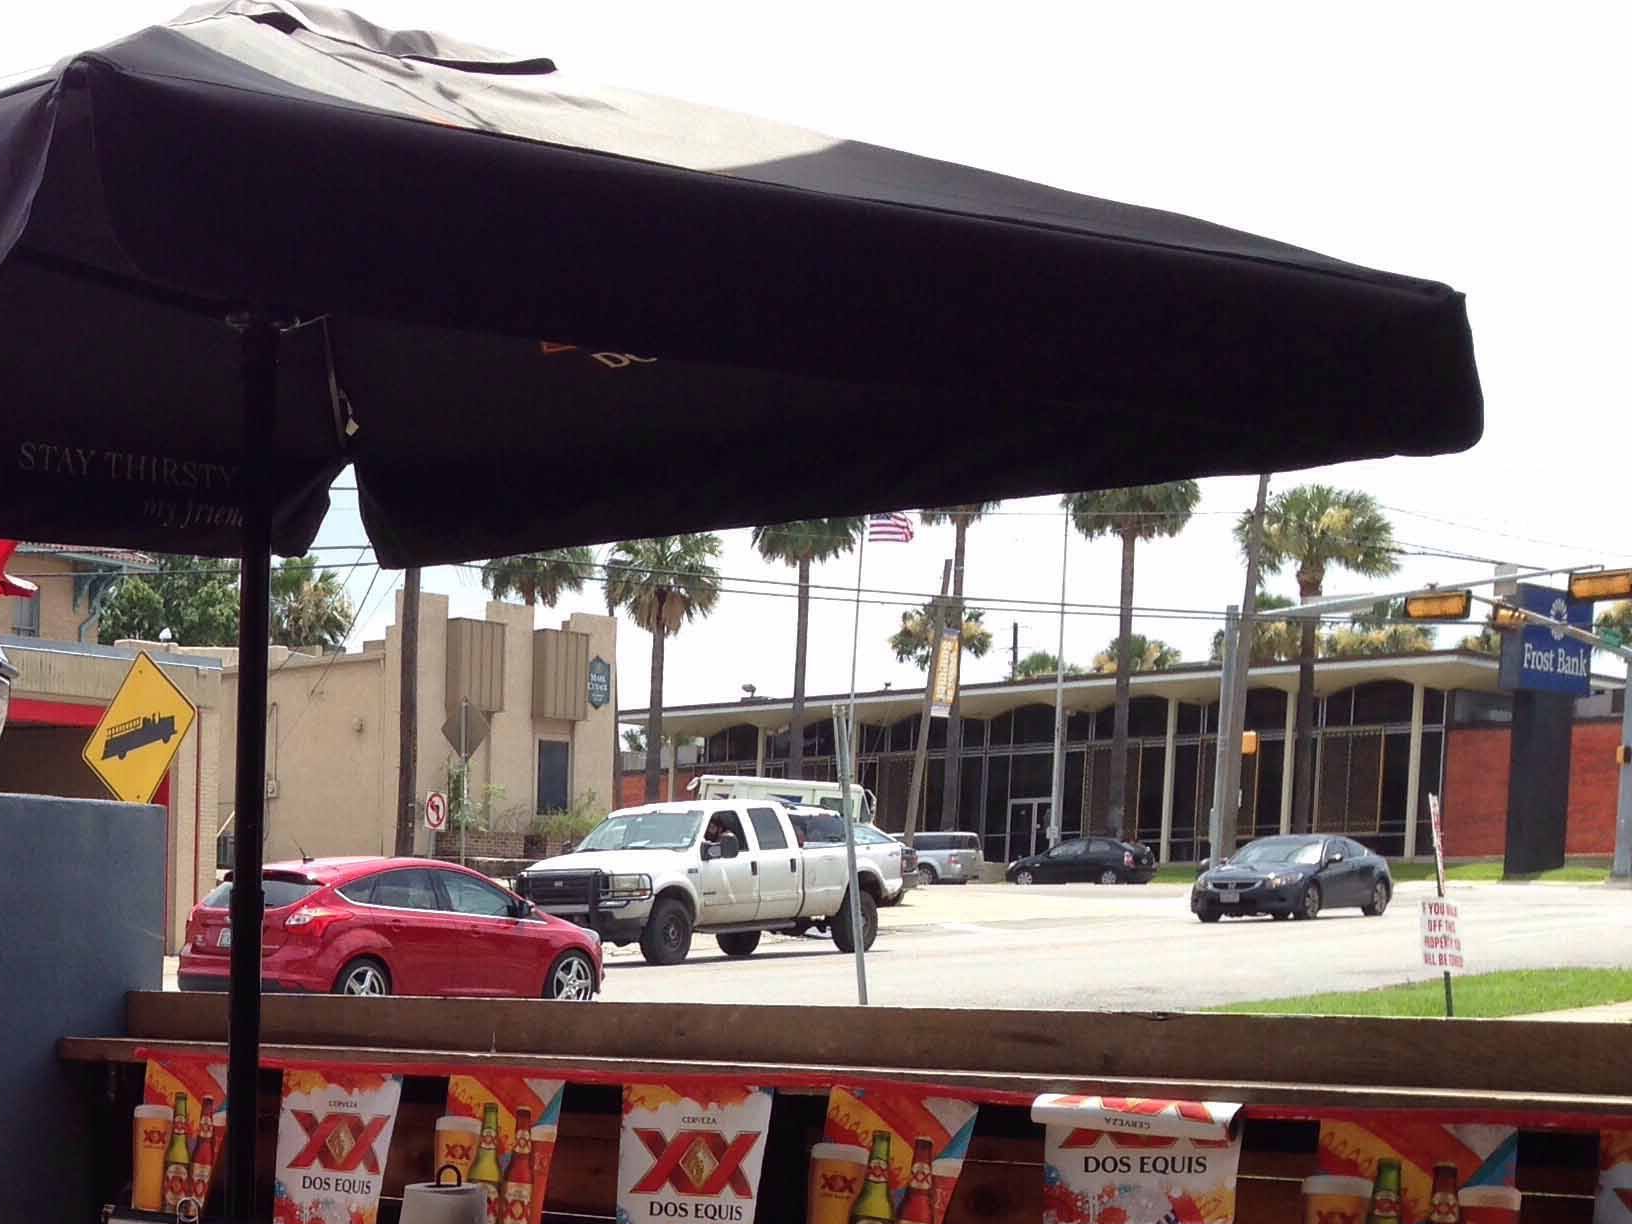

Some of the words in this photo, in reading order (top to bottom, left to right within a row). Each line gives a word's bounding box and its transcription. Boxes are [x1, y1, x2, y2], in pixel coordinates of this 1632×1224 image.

[18, 441, 96, 477] STAY
[1523, 643, 1555, 672] Frost
[1557, 648, 1587, 677] Bank
[1428, 902, 1445, 916] YOU
[1428, 919, 1443, 932] OFF
[1438, 953, 1448, 967] BE
[681, 1116, 717, 1125] CERVEZA
[1104, 1116, 1151, 1129] CERVEZA
[286, 1109, 391, 1174] XX
[629, 1127, 761, 1199] XX
[1083, 1155, 1132, 1174] DOS
[1139, 1155, 1208, 1174] EQUIS
[301, 1175, 331, 1191] DOS
[334, 1178, 372, 1195] EQUIS
[649, 1201, 689, 1218] DOS
[693, 1203, 743, 1221] EQUIS
